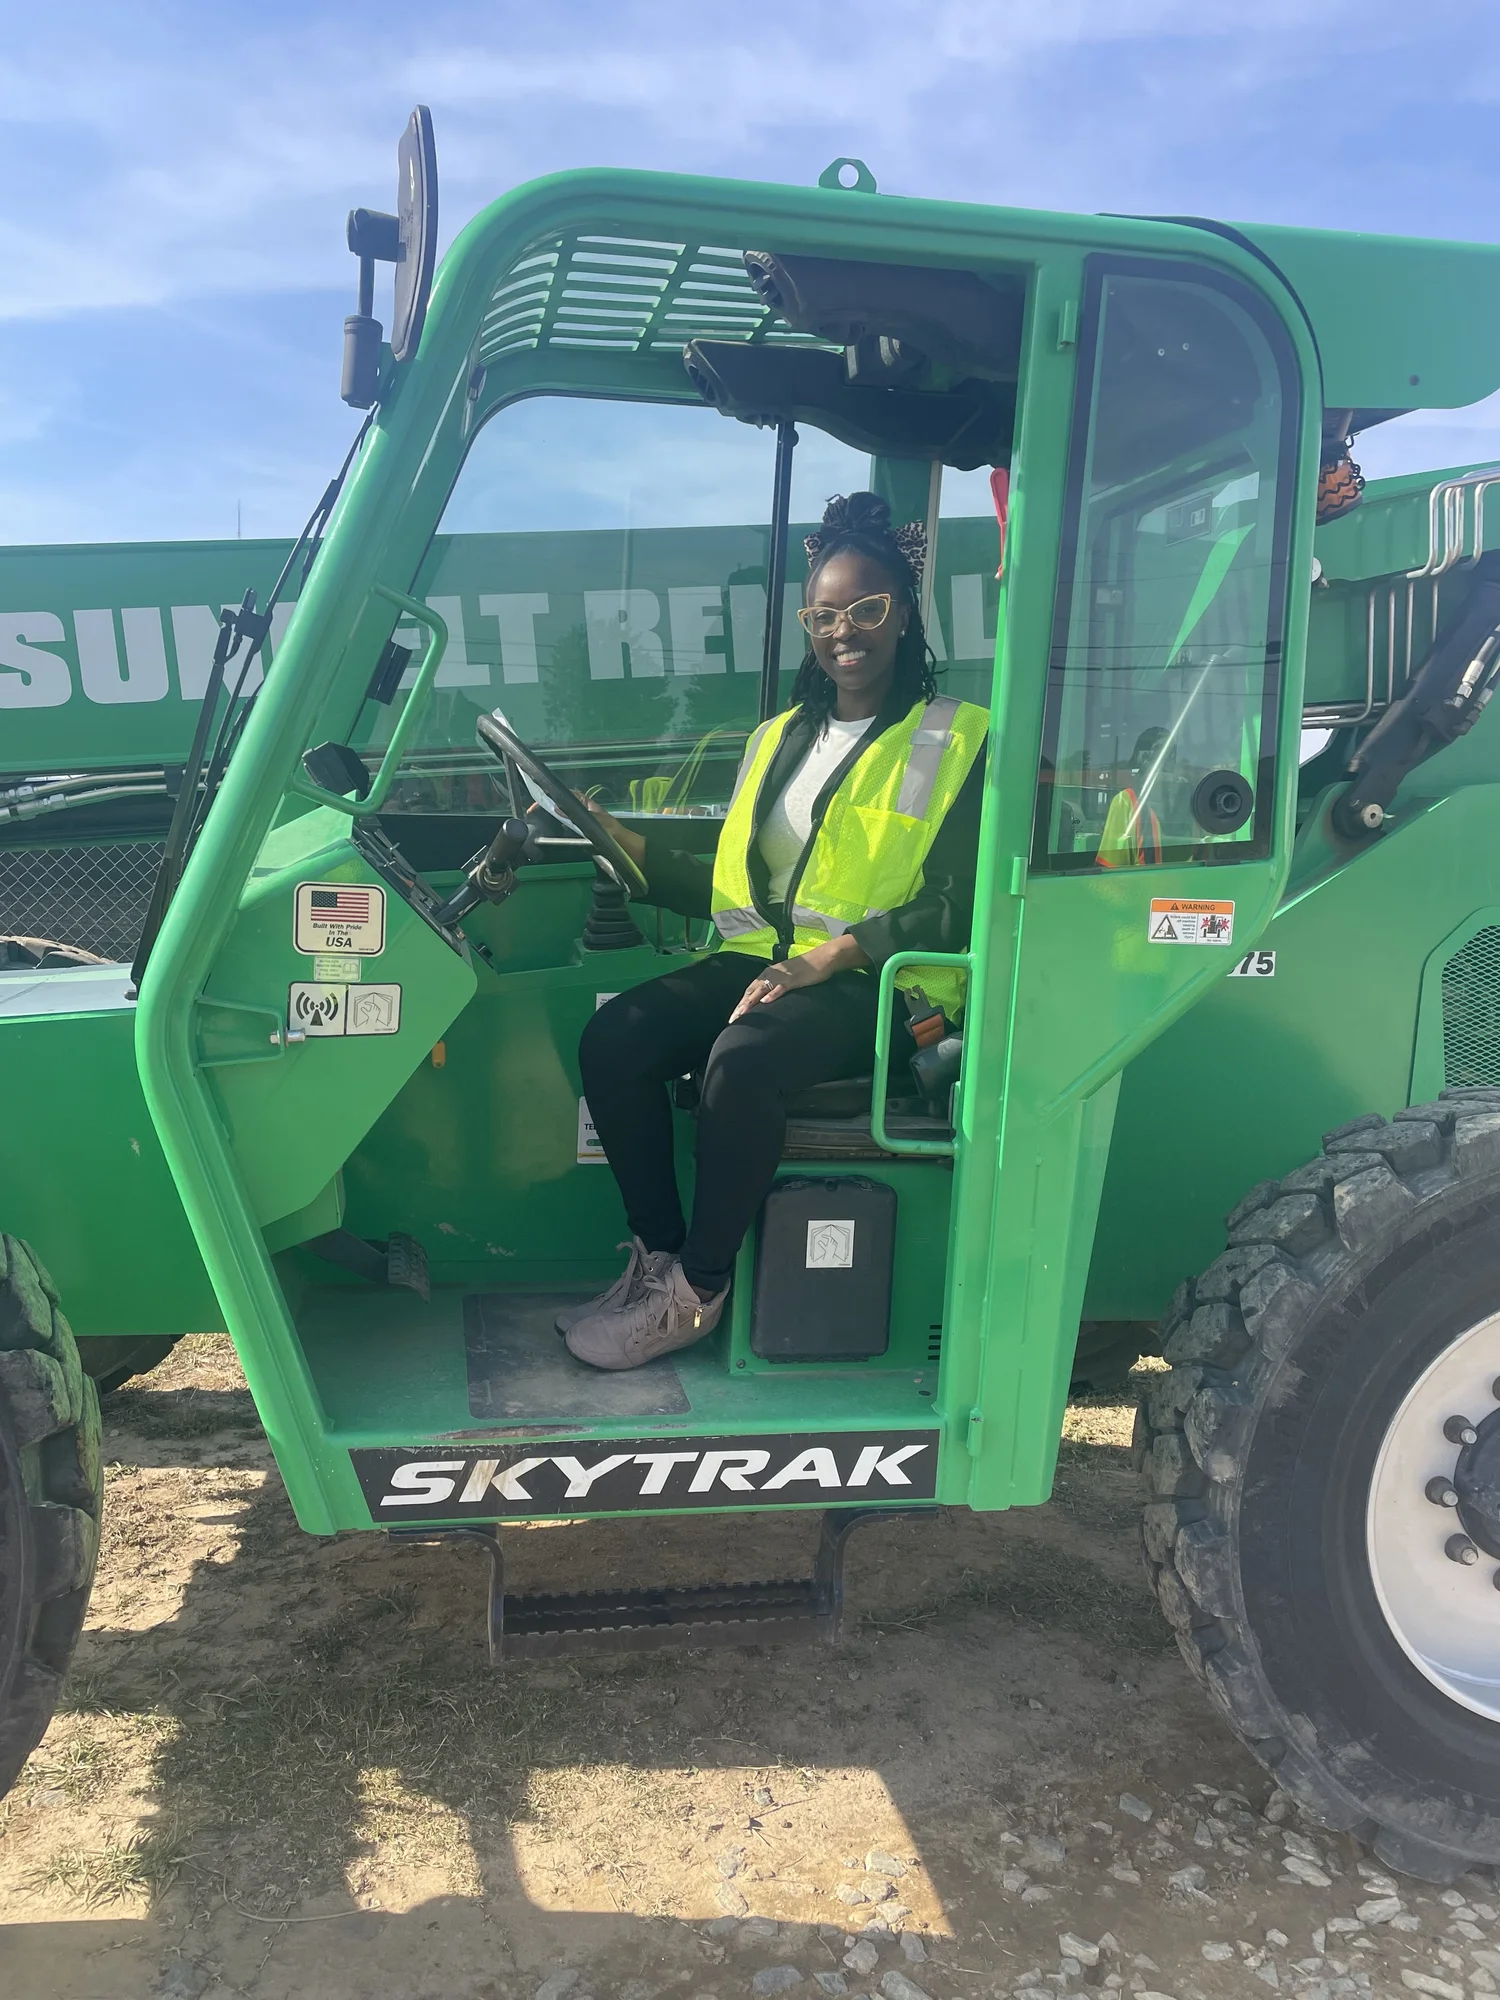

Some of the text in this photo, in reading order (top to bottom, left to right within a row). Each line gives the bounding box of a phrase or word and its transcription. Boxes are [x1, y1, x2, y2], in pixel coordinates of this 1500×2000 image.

[1181, 903, 1216, 911] WARNING
[325, 936, 353, 948] USA
[1229, 951, 1274, 975] 75
[379, 1443, 929, 1507] SKYTRAK
